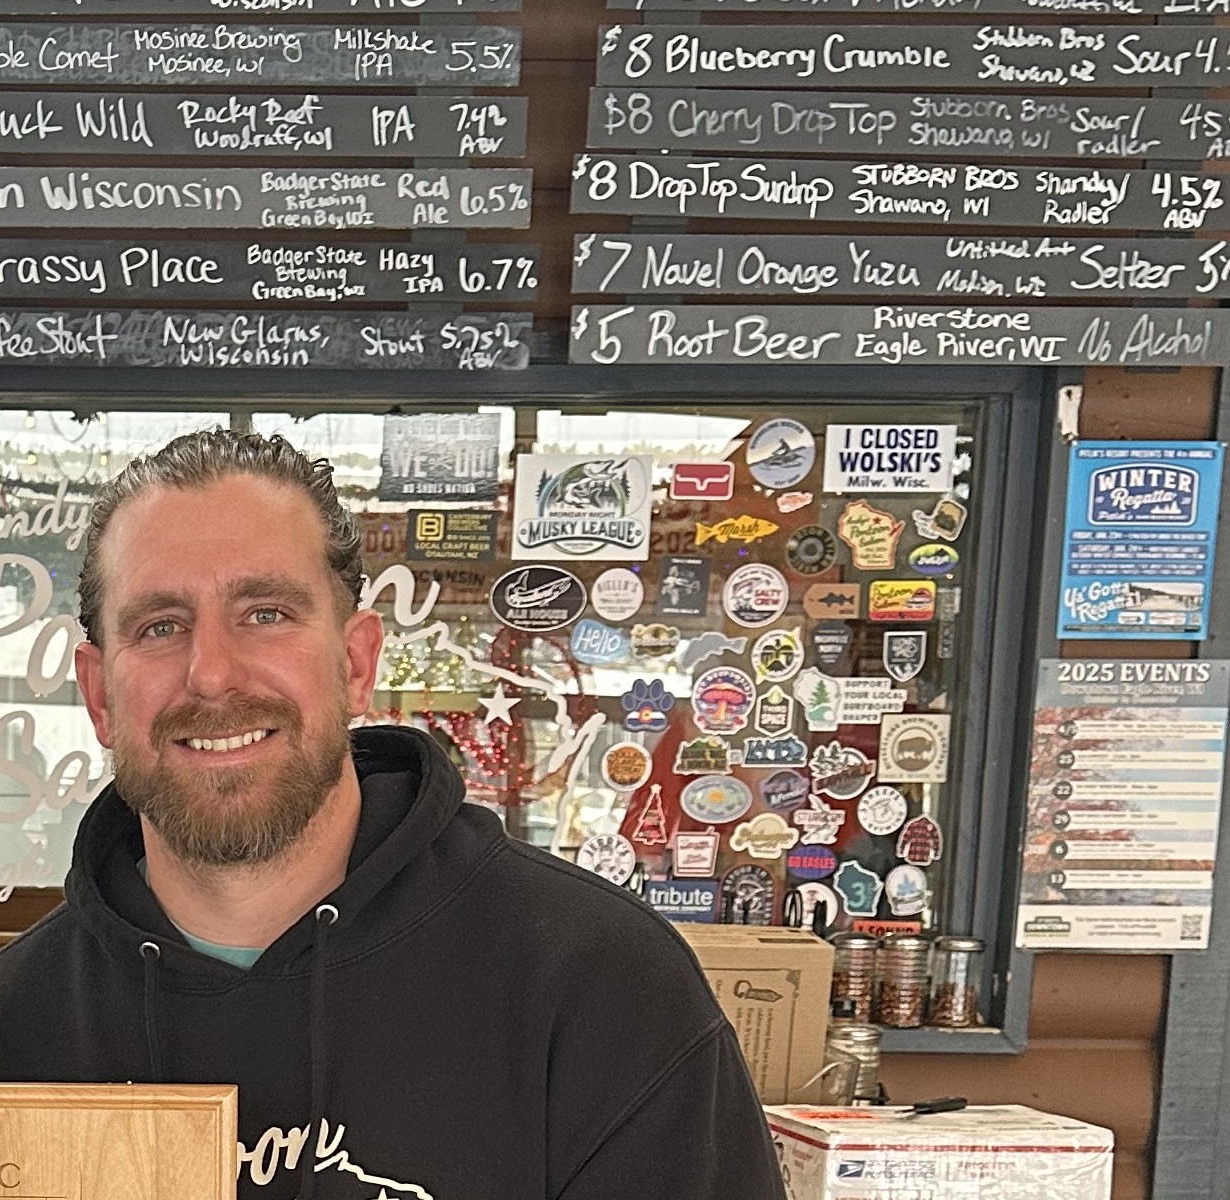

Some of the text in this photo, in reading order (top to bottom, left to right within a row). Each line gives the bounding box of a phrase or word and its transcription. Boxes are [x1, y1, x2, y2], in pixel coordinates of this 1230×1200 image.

[39, 38, 119, 72] Comet
[135, 25, 302, 62] Mosinee Brewing
[445, 42, 514, 72] 5.5%
[601, 24, 951, 78] $8 Blueberry Crumble
[1113, 34, 1191, 76] Sour
[354, 53, 393, 80] IPA
[76, 97, 153, 147] Wild
[372, 105, 416, 146] IPA
[40, 173, 242, 211] Wisconsin
[397, 174, 451, 199] Red
[965, 166, 1020, 191] BROS
[1151, 172, 1224, 209] 4.5%
[460, 183, 528, 216] 6.5%
[1043, 200, 1119, 225] Radler
[413, 204, 450, 225] Ale
[120, 247, 223, 288] Place
[379, 249, 434, 275] Hazy
[458, 258, 538, 293] 6.7%
[574, 234, 920, 294] $7 Navel Orange Yuzu
[1070, 244, 1186, 291] Seltzer
[402, 277, 444, 294] IPA
[571, 306, 841, 364] $5 Root Beer
[855, 332, 1067, 364] Eagle River, WI
[1078, 314, 1212, 363] No Alcohol
[845, 428, 938, 449] I CLOSED
[839, 451, 941, 473] WOLSKI'S
[847, 475, 930, 488] Milw. Wisc.
[1098, 469, 1192, 493] WINTER
[1110, 487, 1177, 511] Regatta
[527, 520, 635, 545] MUSKY LEAGUE
[575, 626, 621, 652] Hello
[1057, 662, 1211, 683] 2025 EVENTS
[650, 887, 713, 905] tribute
[850, 881, 866, 909] 3
